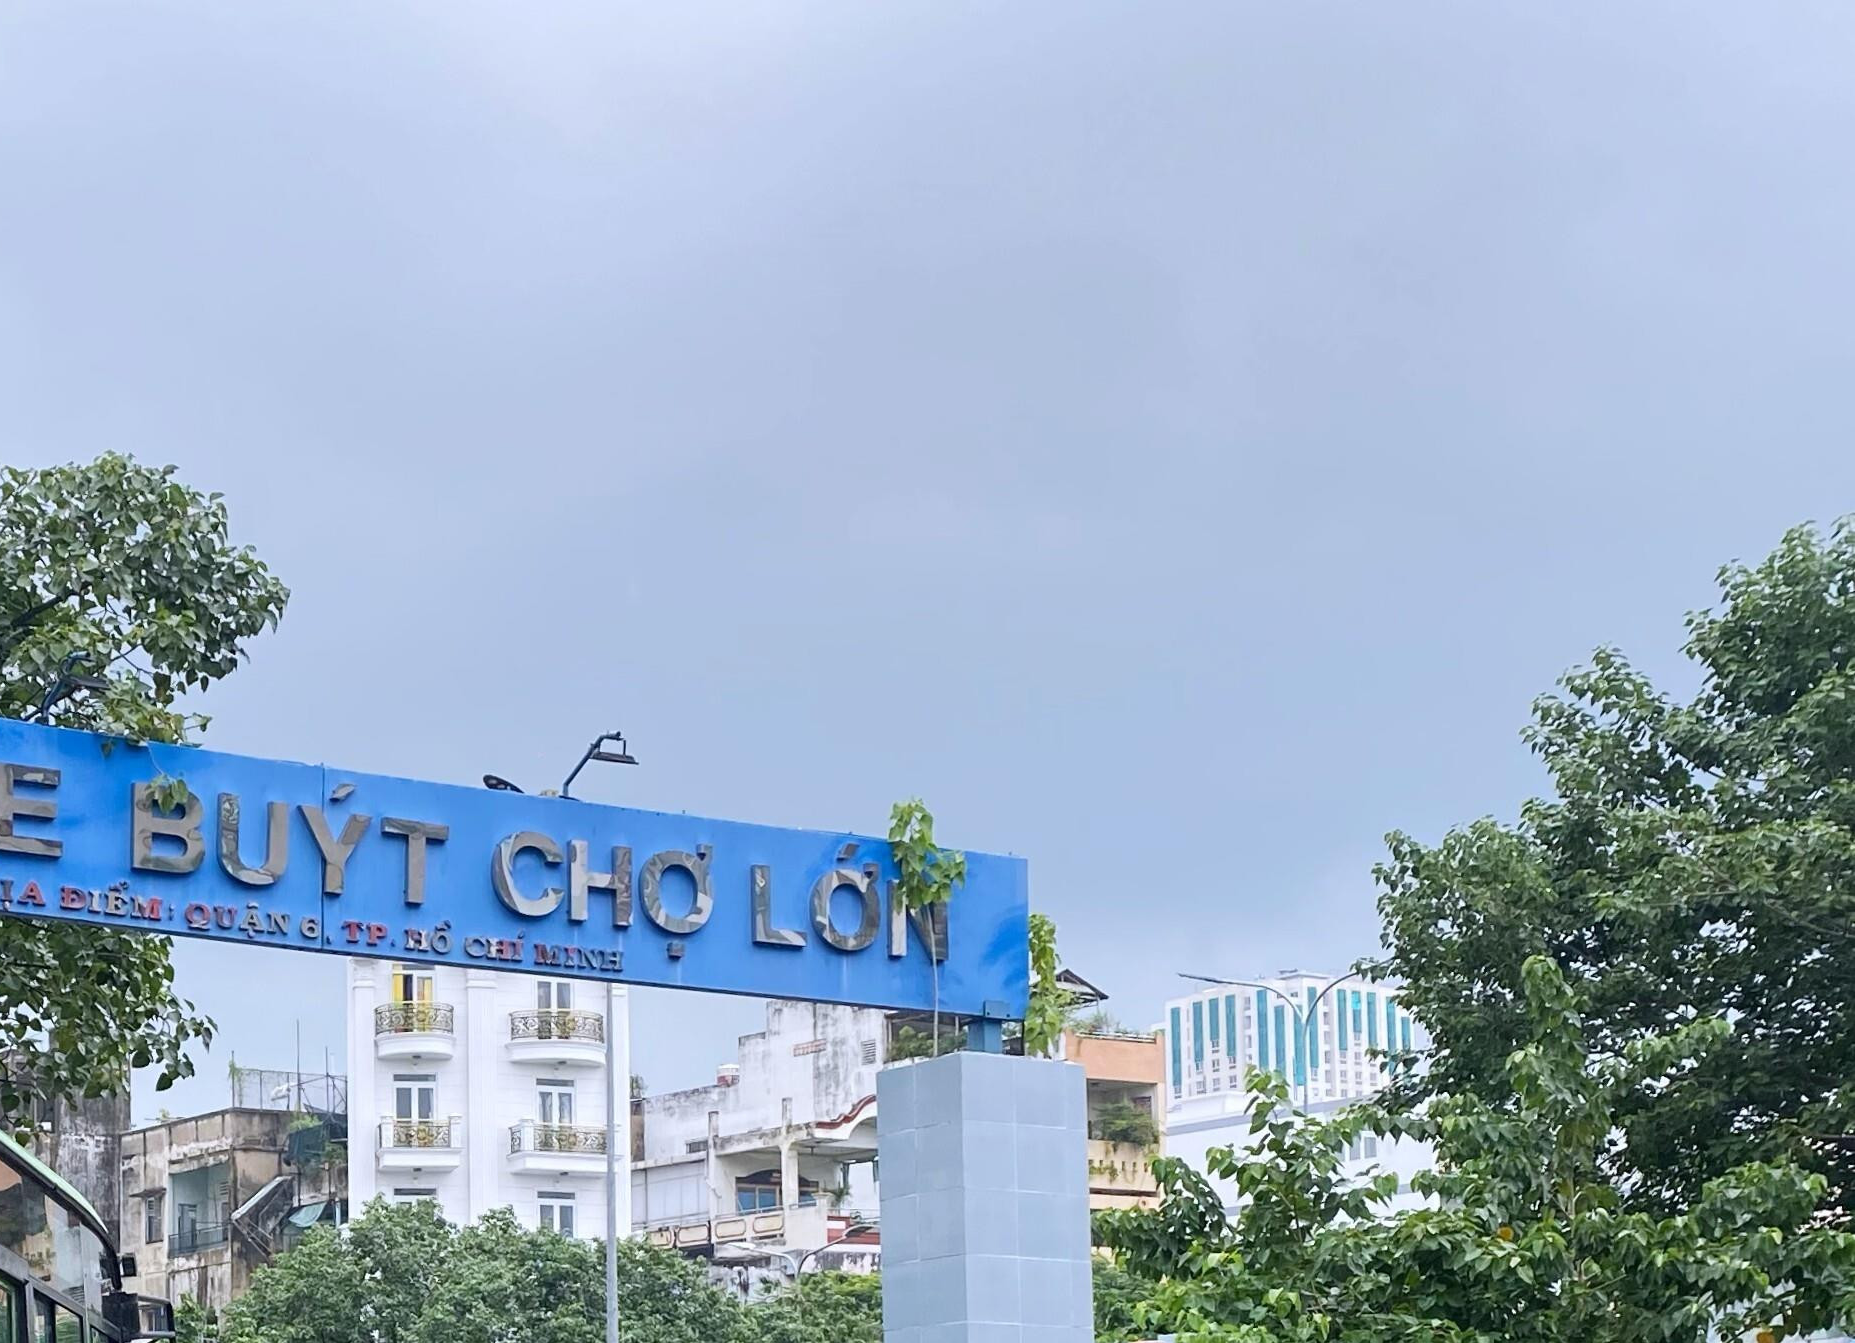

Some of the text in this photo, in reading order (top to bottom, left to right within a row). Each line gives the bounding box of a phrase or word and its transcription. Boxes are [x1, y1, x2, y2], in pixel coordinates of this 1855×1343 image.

[131, 777, 450, 906] BUÝT
[491, 831, 714, 960] CHỢ
[750, 842, 949, 963] LỚN
[184, 901, 291, 939] QUẬN
[404, 919, 453, 955] HỒ
[464, 930, 525, 962] CHÍ
[533, 943, 625, 973] MINH
